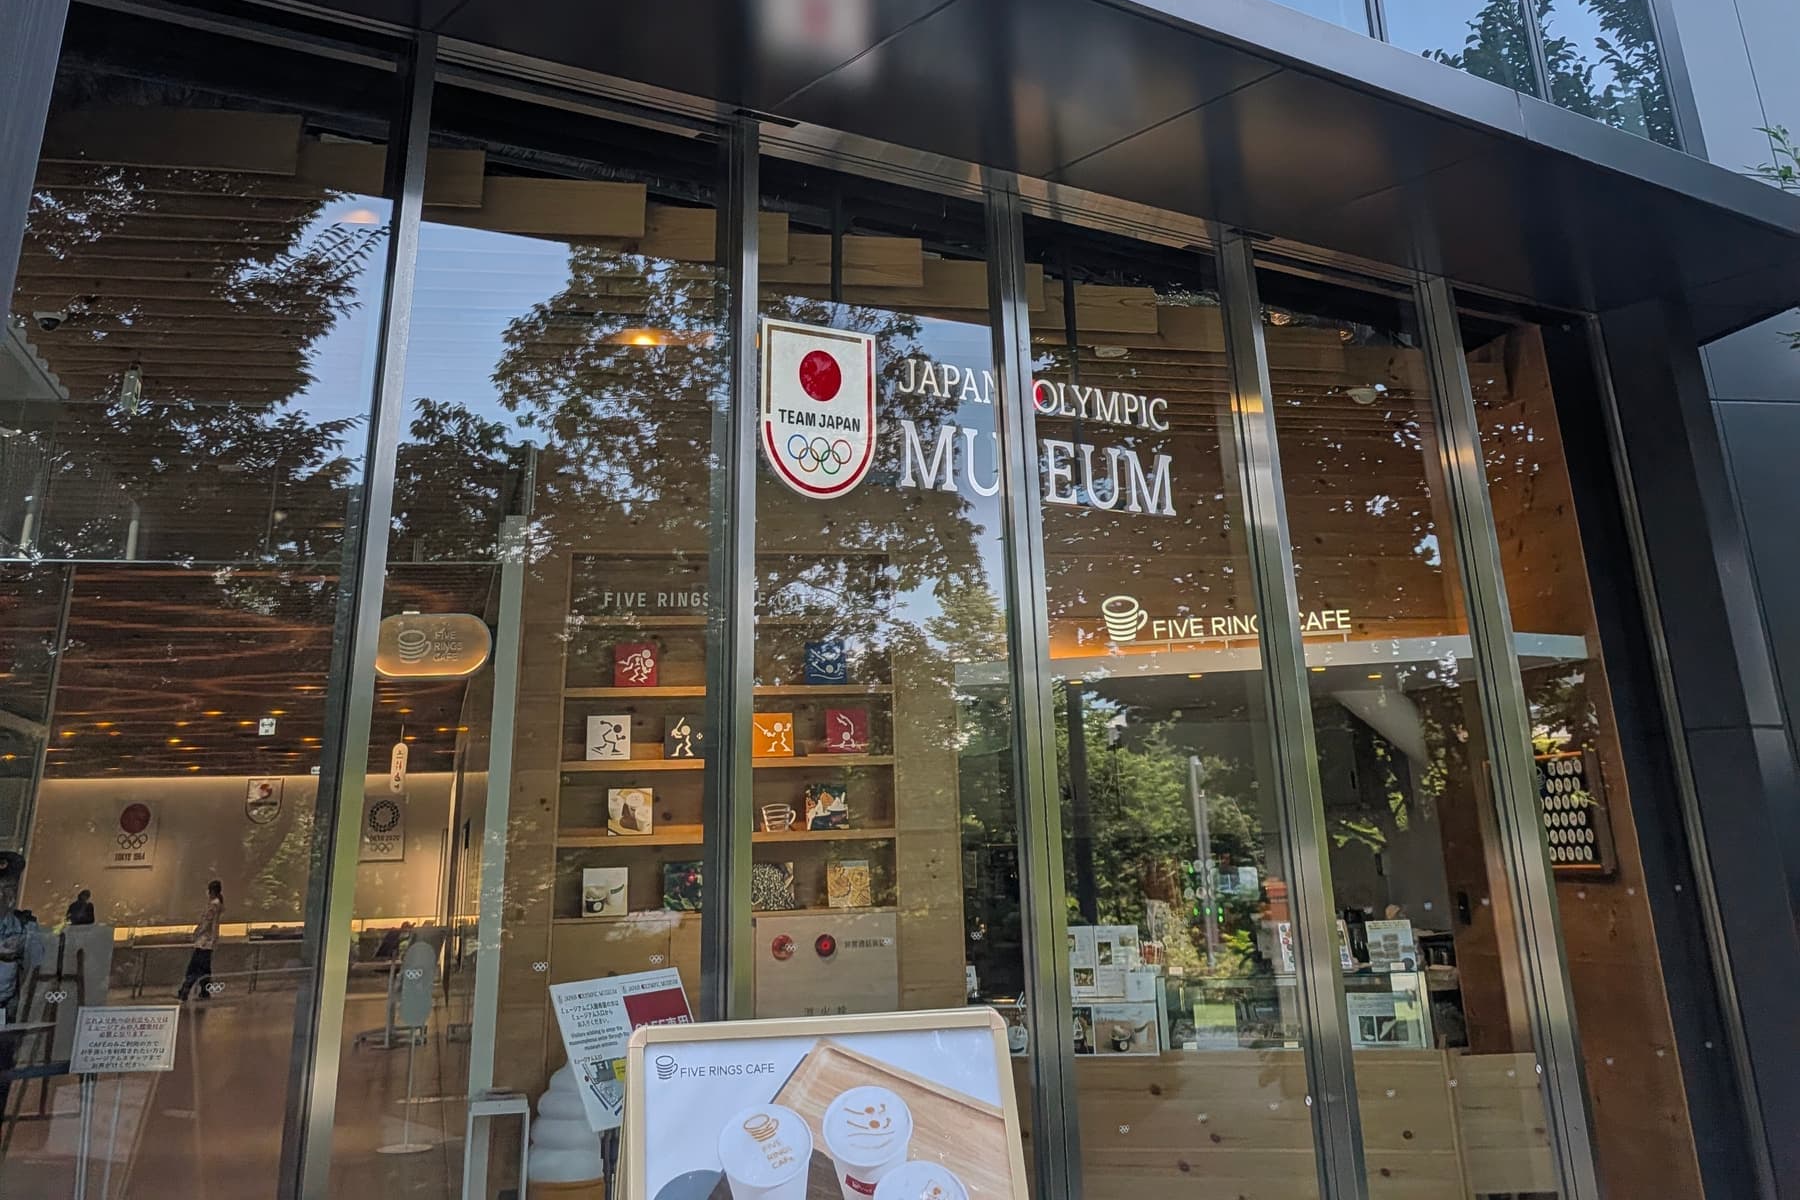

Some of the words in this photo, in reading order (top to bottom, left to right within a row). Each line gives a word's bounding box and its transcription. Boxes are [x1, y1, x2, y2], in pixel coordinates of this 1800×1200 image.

[1033, 379, 1170, 432] OLYMPIC
[778, 408, 817, 428] TEAM
[818, 413, 861, 433] JAPAN
[900, 419, 1177, 517] MUEUM
[603, 591, 647, 608] FIVE
[1152, 616, 1204, 640] FIVE
[1210, 614, 1259, 636] RIN
[434, 631, 456, 641] FIVE
[433, 641, 463, 651] RINGS
[432, 652, 459, 662] CAFE
[680, 1066, 706, 1078] FIVE
[709, 1064, 743, 1077] RINGS
[746, 1062, 775, 1075] CAFE
